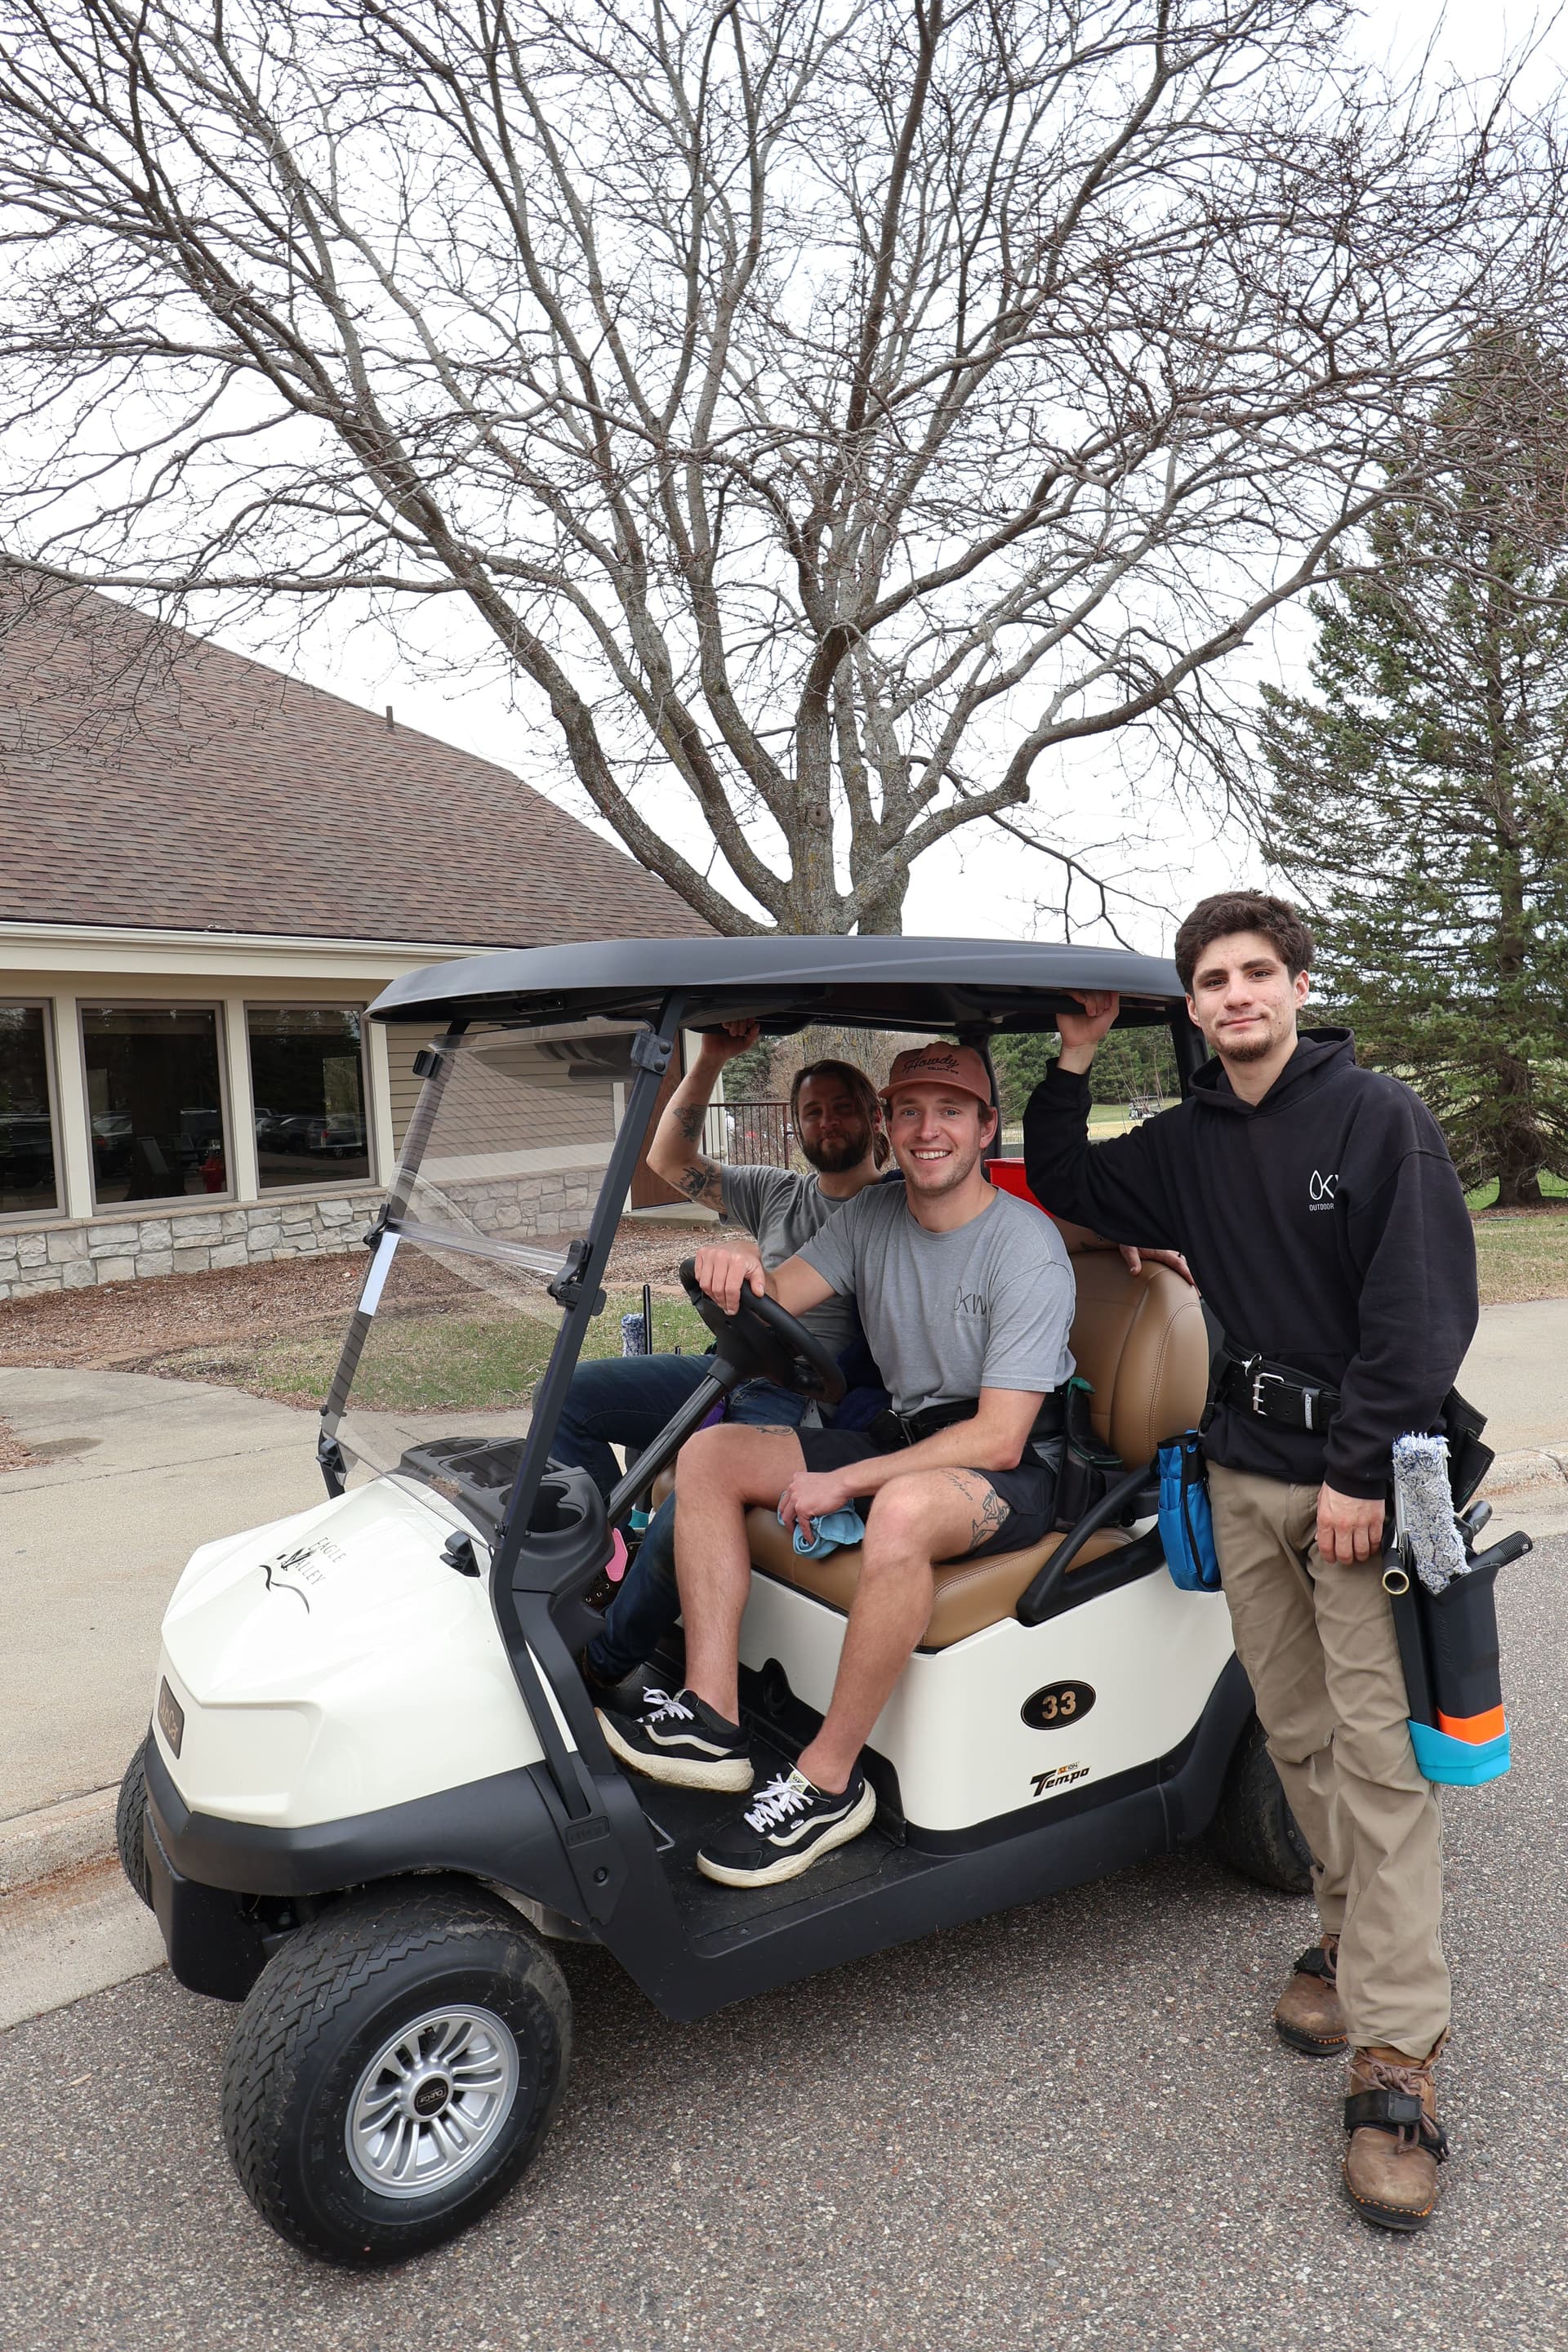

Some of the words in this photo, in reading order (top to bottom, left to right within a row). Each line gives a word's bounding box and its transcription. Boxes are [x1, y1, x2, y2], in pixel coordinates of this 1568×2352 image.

[902, 1054, 960, 1073] Howdy
[1309, 1203, 1334, 1211] OUTDOOR
[308, 1537, 347, 1563] EAGLE
[1041, 1690, 1077, 1720] 33
[1030, 1767, 1091, 1797] Tempo
